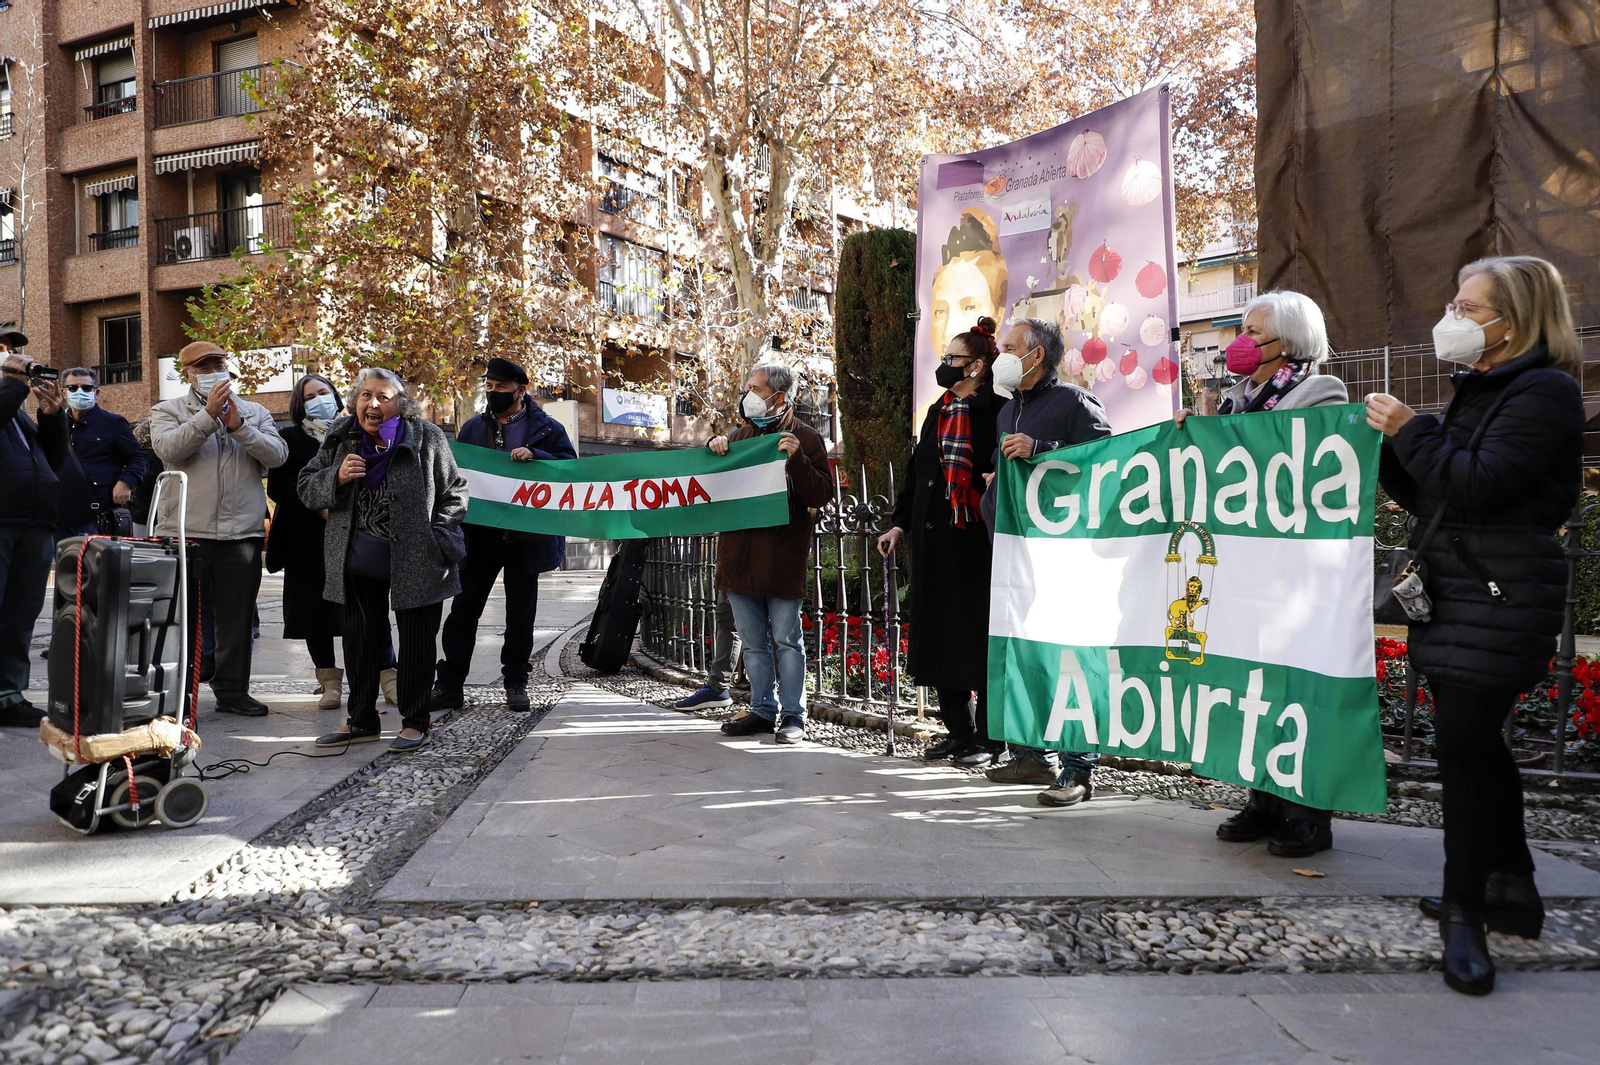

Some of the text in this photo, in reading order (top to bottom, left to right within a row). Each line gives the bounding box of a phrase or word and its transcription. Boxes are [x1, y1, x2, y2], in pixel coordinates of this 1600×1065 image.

[953, 164, 1067, 202] Plataforma Granada Abierta
[510, 476, 712, 512] NO A LA TOMA
[1026, 418, 1361, 535] Granada
